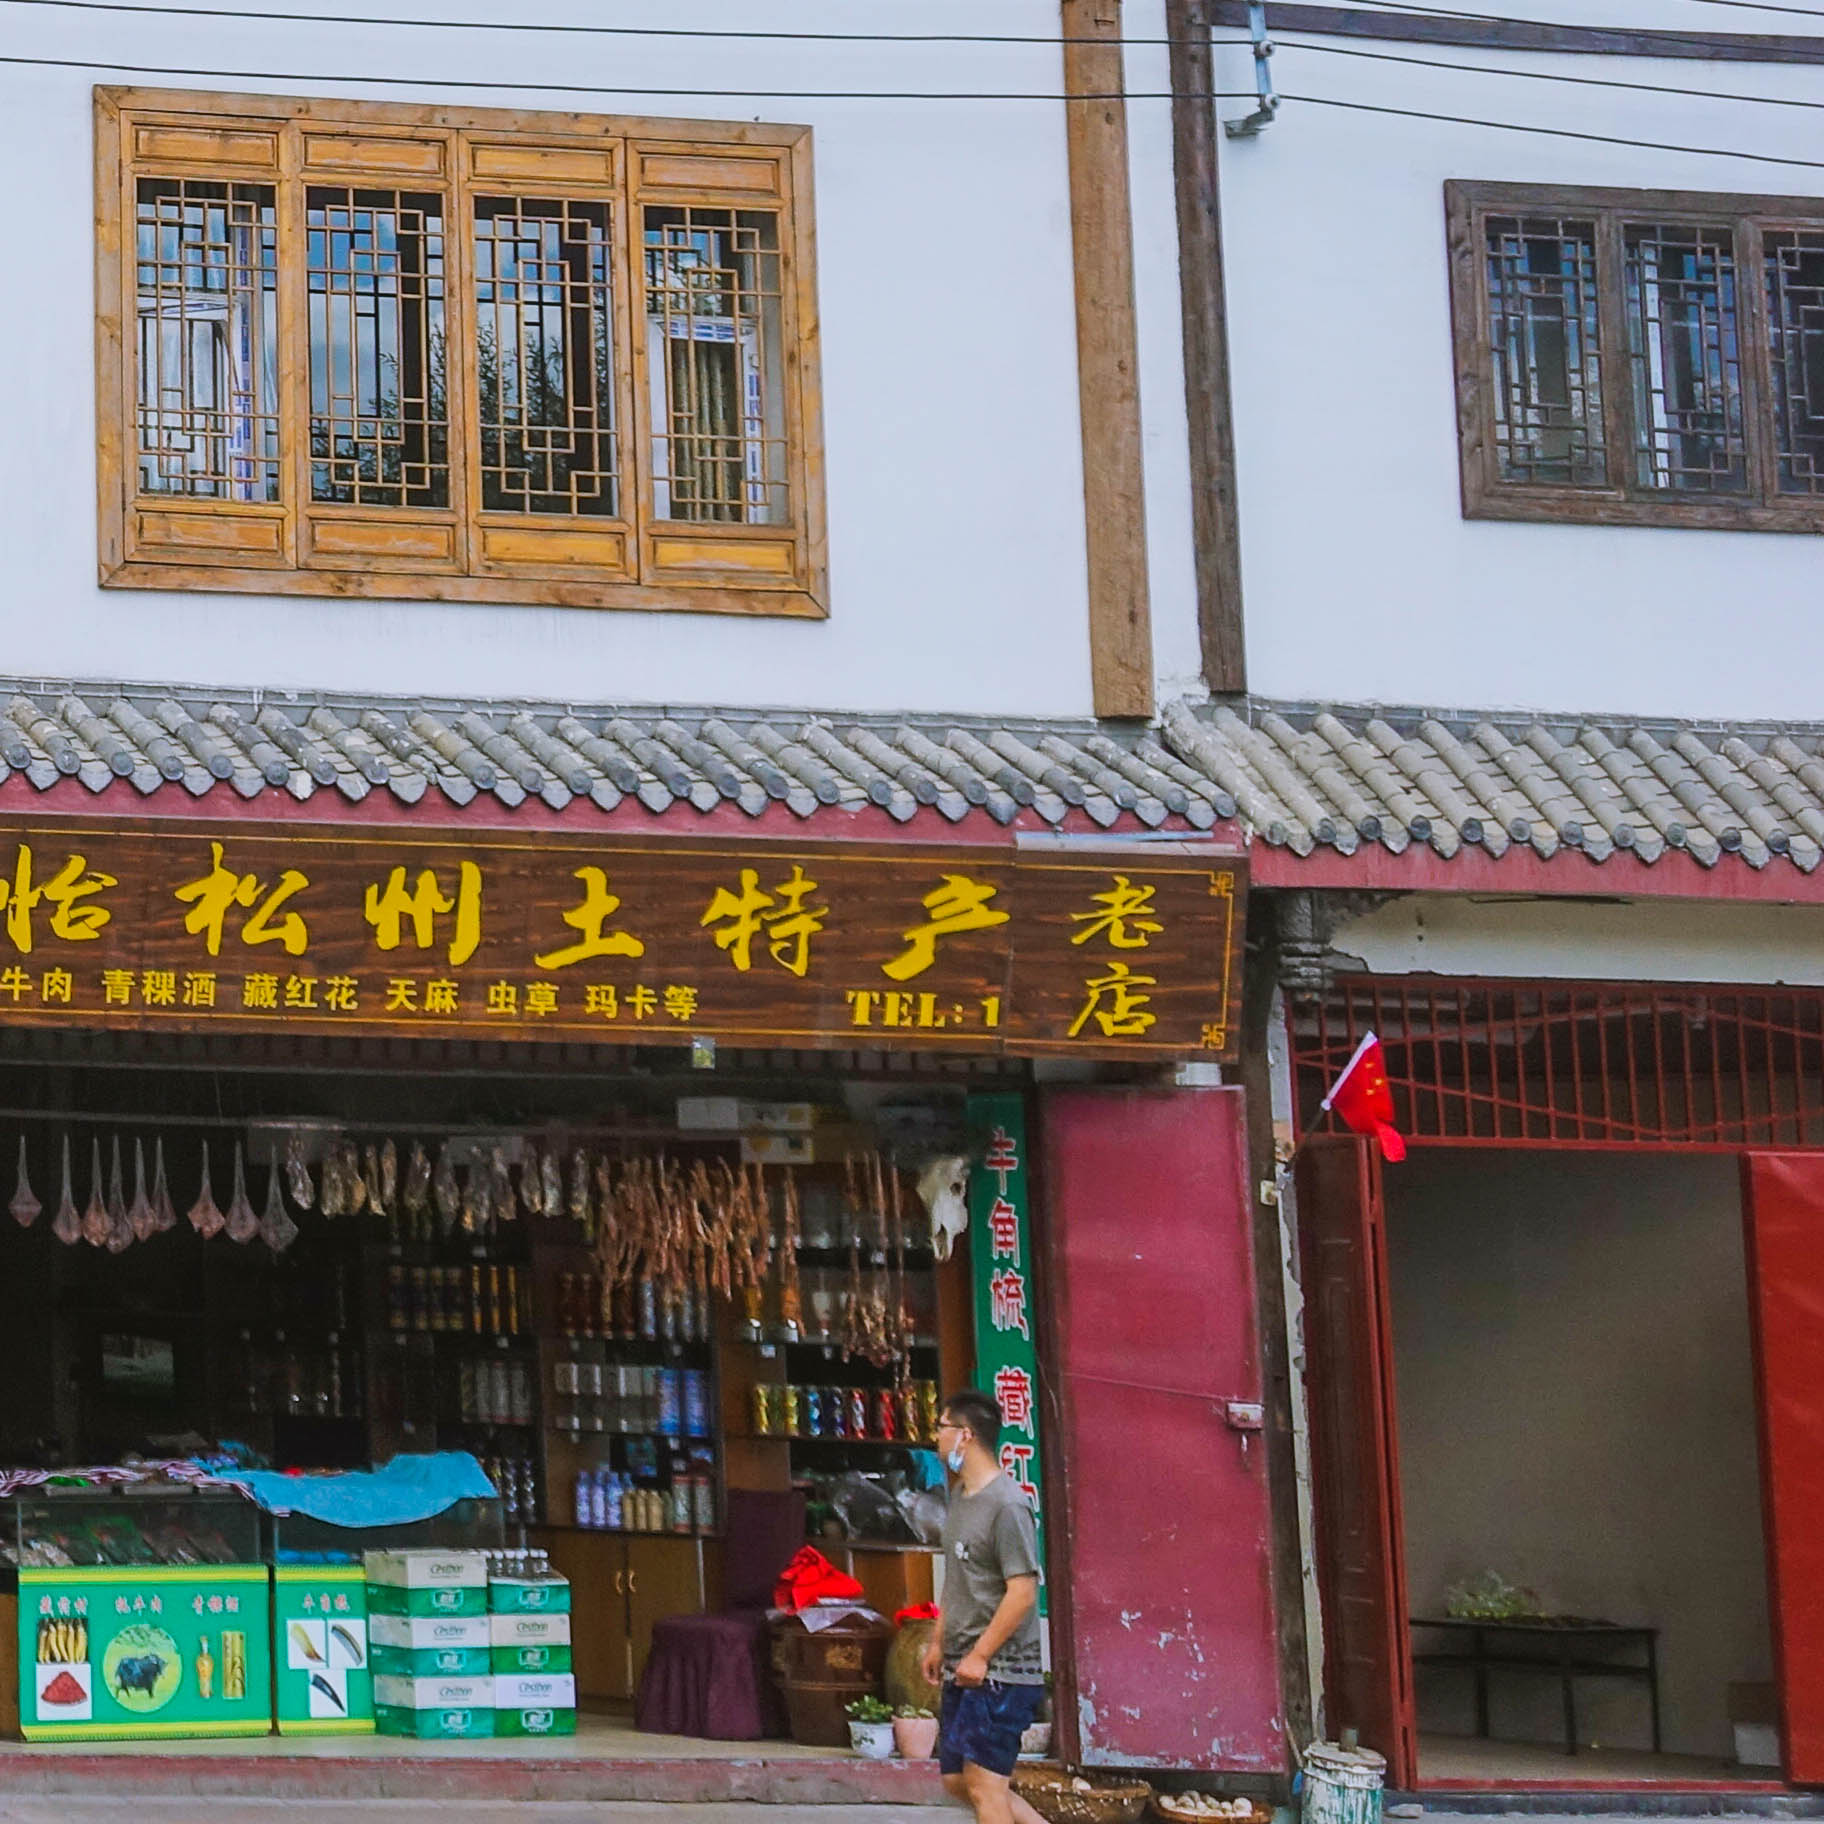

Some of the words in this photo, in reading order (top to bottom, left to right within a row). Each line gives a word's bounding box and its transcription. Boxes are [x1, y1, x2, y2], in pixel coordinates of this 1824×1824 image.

[102, 968, 217, 1007] 青稞酒
[242, 972, 360, 1011] 藏红花
[384, 977, 460, 1015] 天麻
[483, 979, 560, 1017] 虫草
[582, 983, 699, 1022] 玛卡等
[1067, 875, 1165, 1038] 老店
[984, 1126, 1030, 1340] 牛角梳
